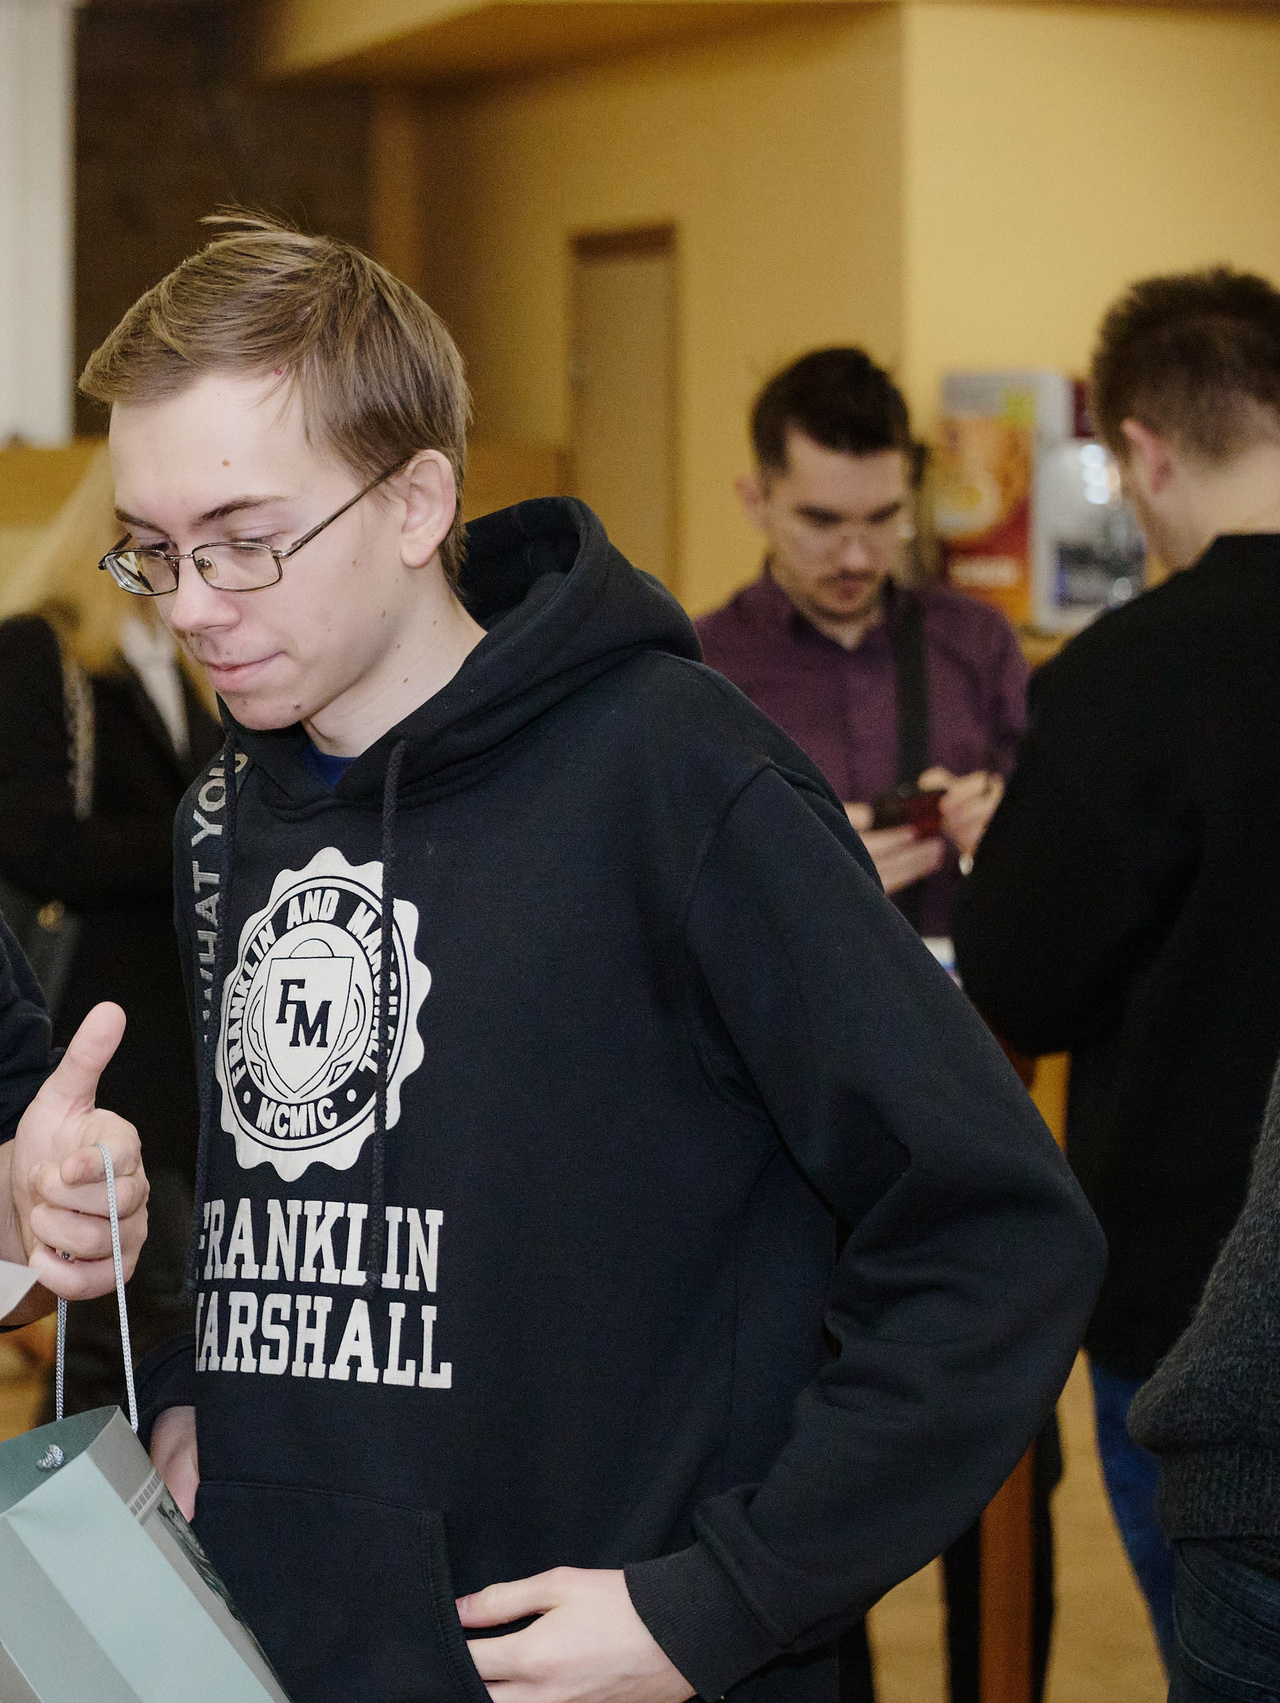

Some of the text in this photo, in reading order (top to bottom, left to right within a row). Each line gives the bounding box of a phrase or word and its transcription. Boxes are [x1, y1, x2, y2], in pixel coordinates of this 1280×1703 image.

[228, 921, 276, 1087] FRANKLIN
[286, 889, 340, 929] AND
[276, 979, 332, 1048] FM
[256, 1097, 338, 1137] MCMIC
[195, 1291, 452, 1389] ARSHALL
